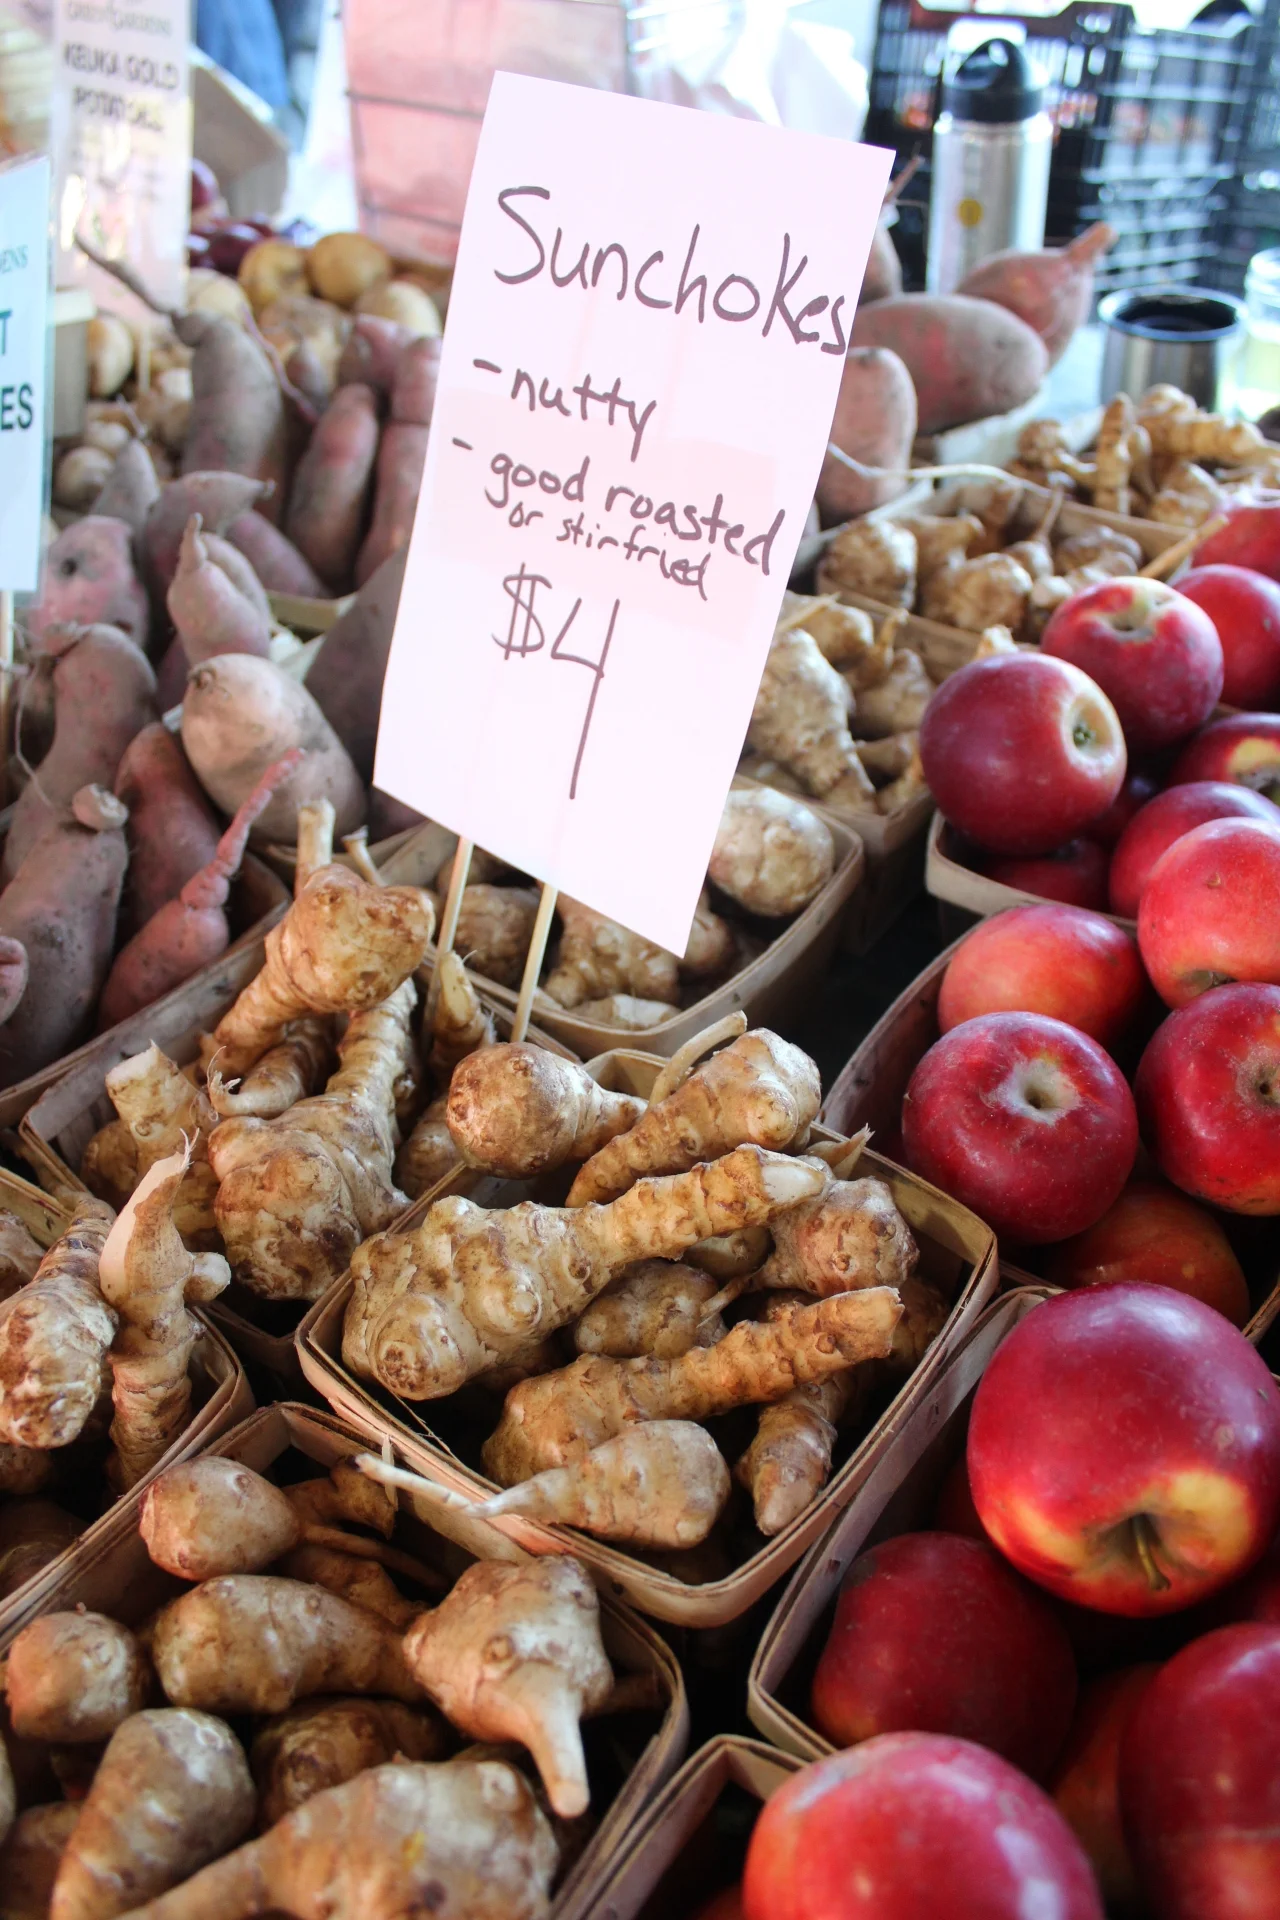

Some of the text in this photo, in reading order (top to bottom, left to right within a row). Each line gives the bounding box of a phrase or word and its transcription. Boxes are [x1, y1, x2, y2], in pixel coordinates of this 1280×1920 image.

[123, 54, 180, 91] GOLD
[73, 85, 165, 132] POTATO
[484, 453, 591, 509] good
[604, 485, 786, 577] roasted
[508, 501, 544, 528] or
[492, 562, 621, 801] $4
